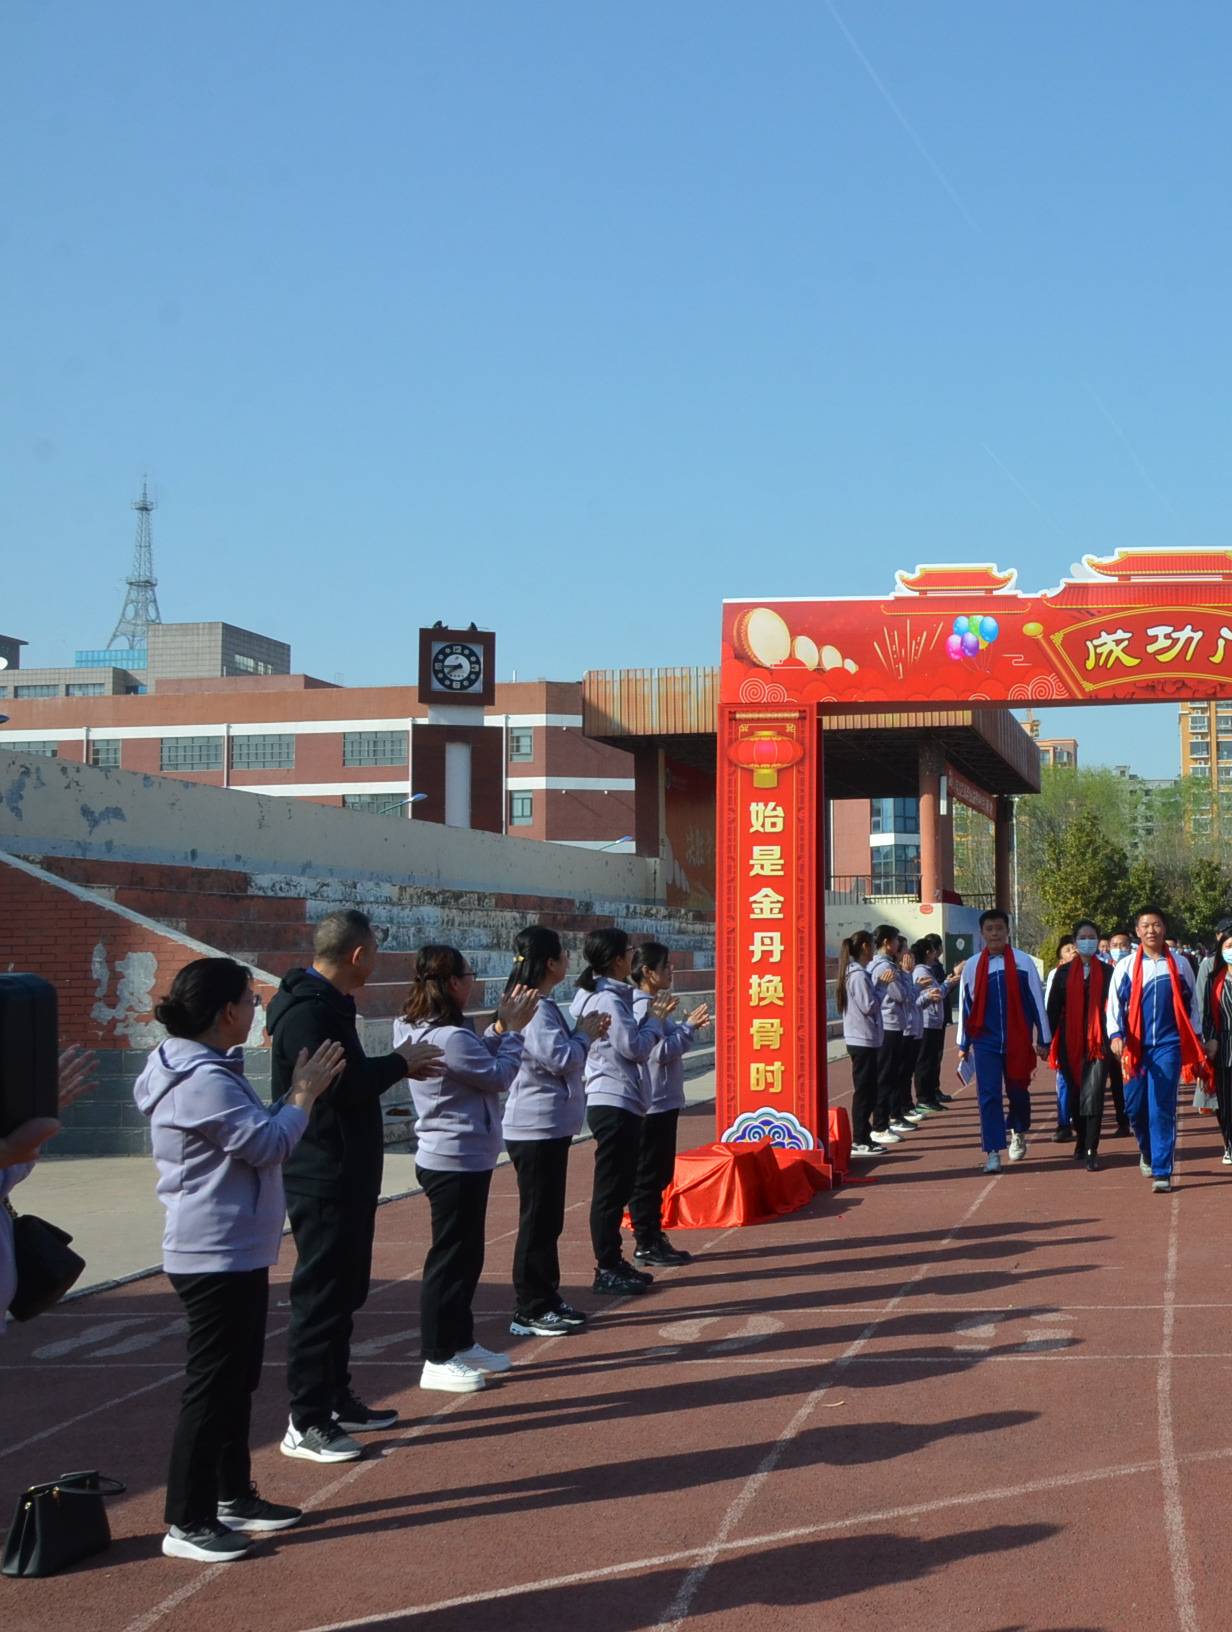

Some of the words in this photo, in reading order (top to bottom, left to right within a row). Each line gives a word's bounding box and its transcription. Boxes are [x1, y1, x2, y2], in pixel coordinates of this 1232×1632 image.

[749, 801, 785, 1093] 始是金丹换骨时
